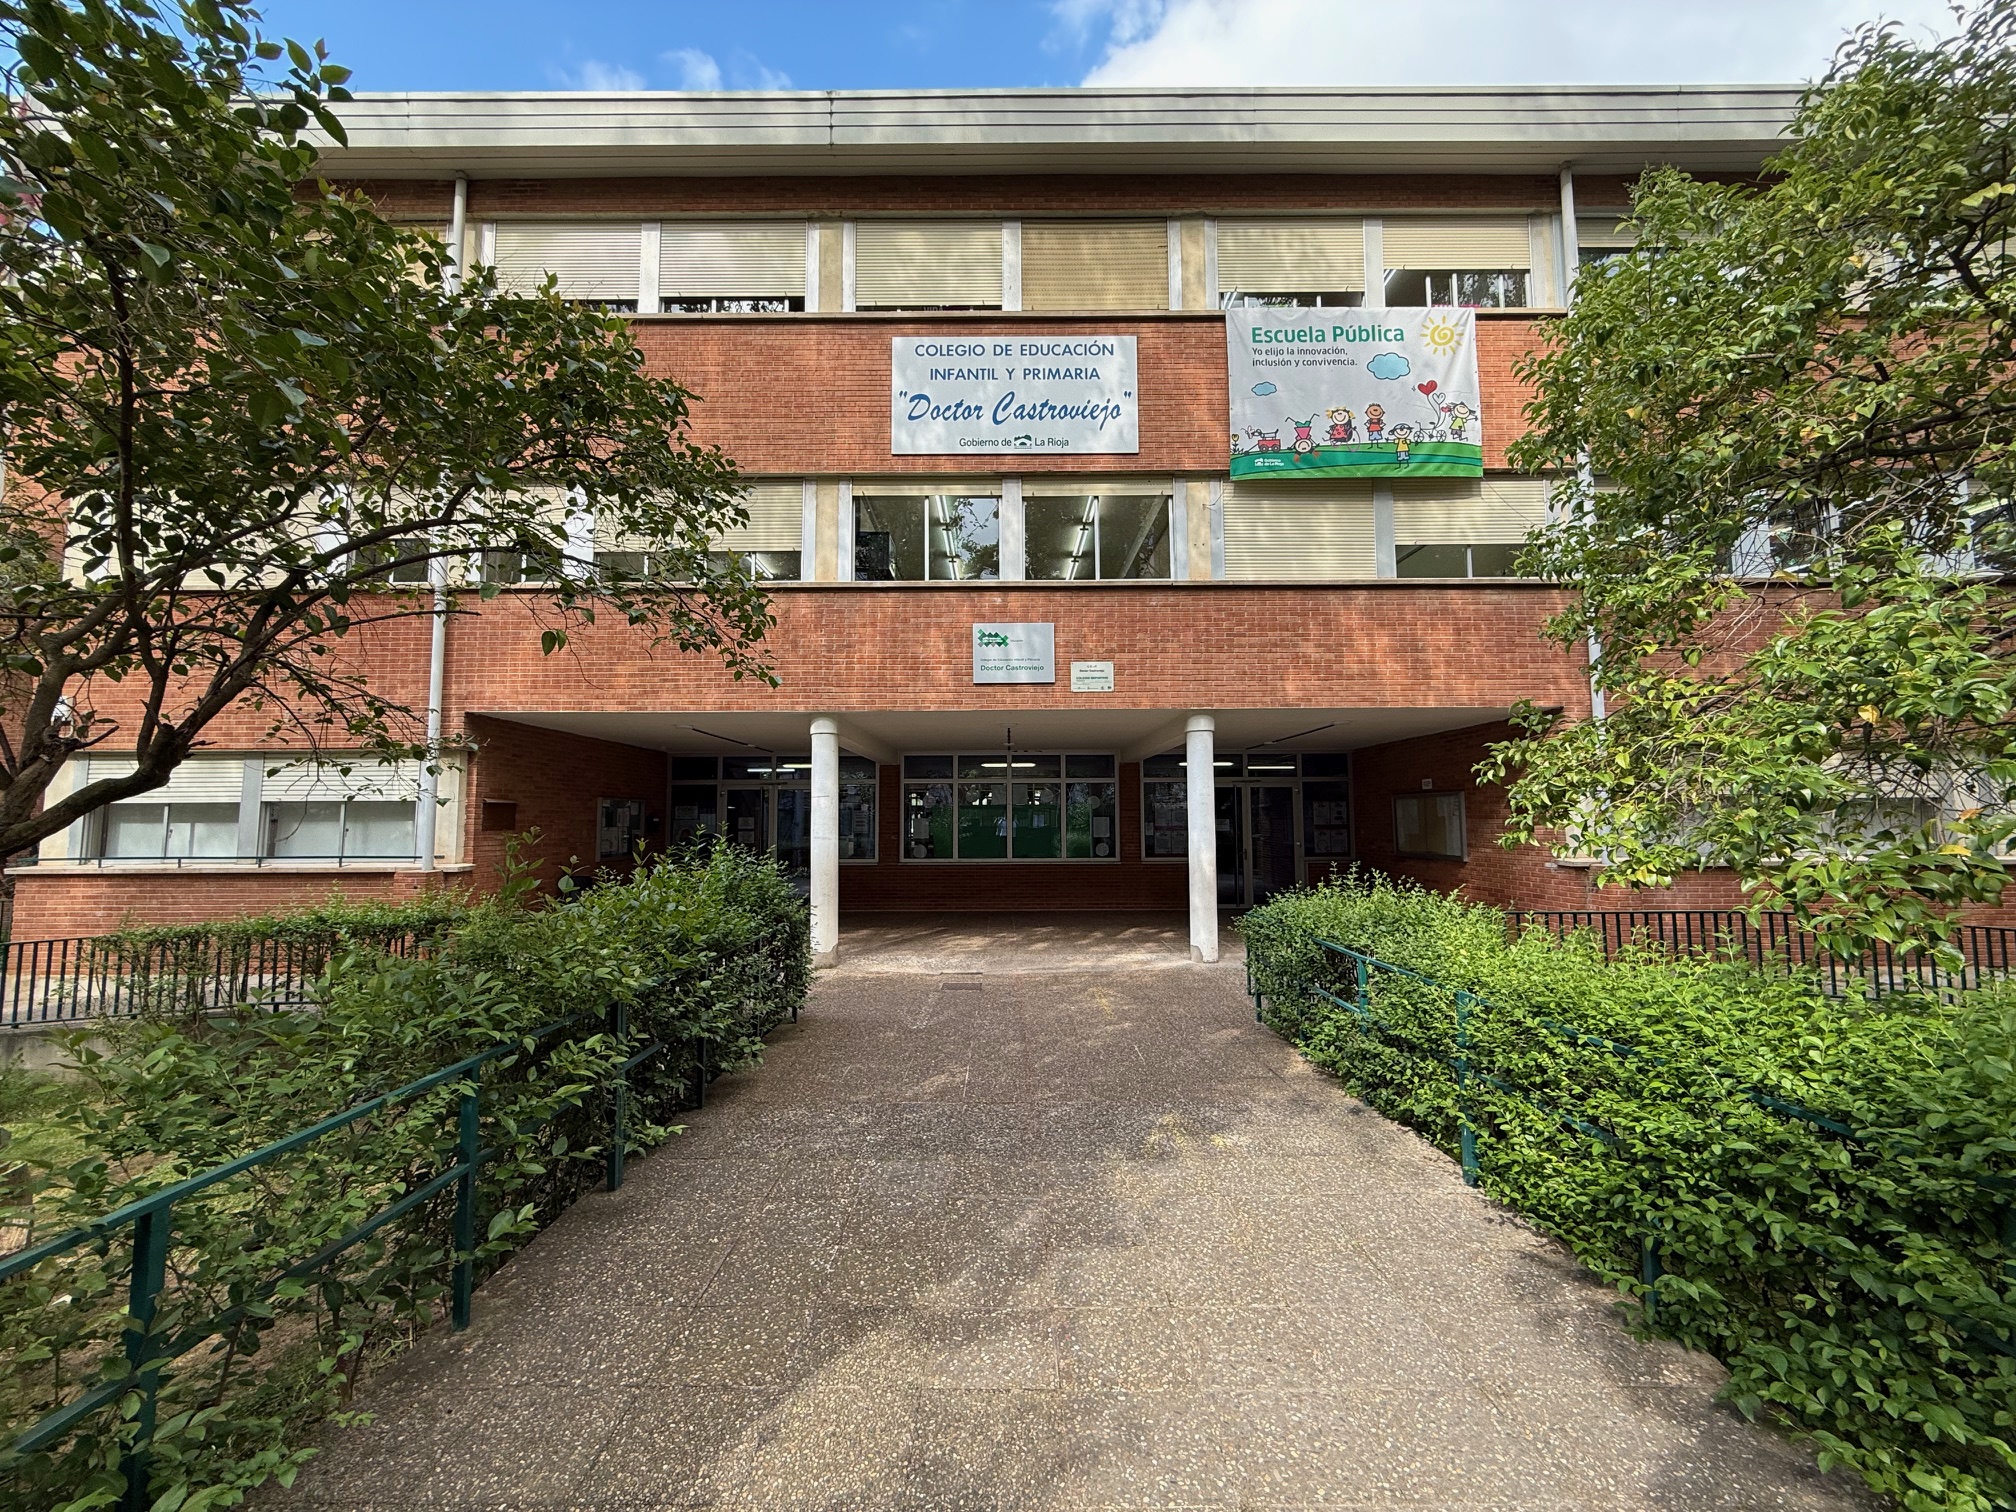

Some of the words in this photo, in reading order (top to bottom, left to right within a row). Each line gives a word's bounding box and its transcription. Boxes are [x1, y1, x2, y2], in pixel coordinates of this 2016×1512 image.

[1251, 325, 1326, 344] Escuela
[1332, 324, 1405, 343] Pública
[914, 344, 986, 357] COLEGIO
[993, 344, 1013, 356] DE
[1020, 340, 1115, 356] EDUCACIÓN
[1251, 347, 1263, 356] Yo
[1264, 347, 1284, 357] elijo
[1286, 346, 1295, 356] la
[1297, 346, 1348, 356] innovación,
[1294, 359, 1300, 368] y
[1302, 357, 1358, 367] convivencia.
[929, 368, 999, 381] INFANTIL
[1005, 368, 1016, 380] Y
[1023, 367, 1101, 380] PRIMARIA
[898, 390, 984, 422] "Doctor
[959, 437, 1000, 448] Gobierno
[1001, 437, 1013, 447] de
[1034, 437, 1046, 447] La
[1047, 437, 1070, 449] Rioja
[1005, 664, 1045, 672] Castroviejo
